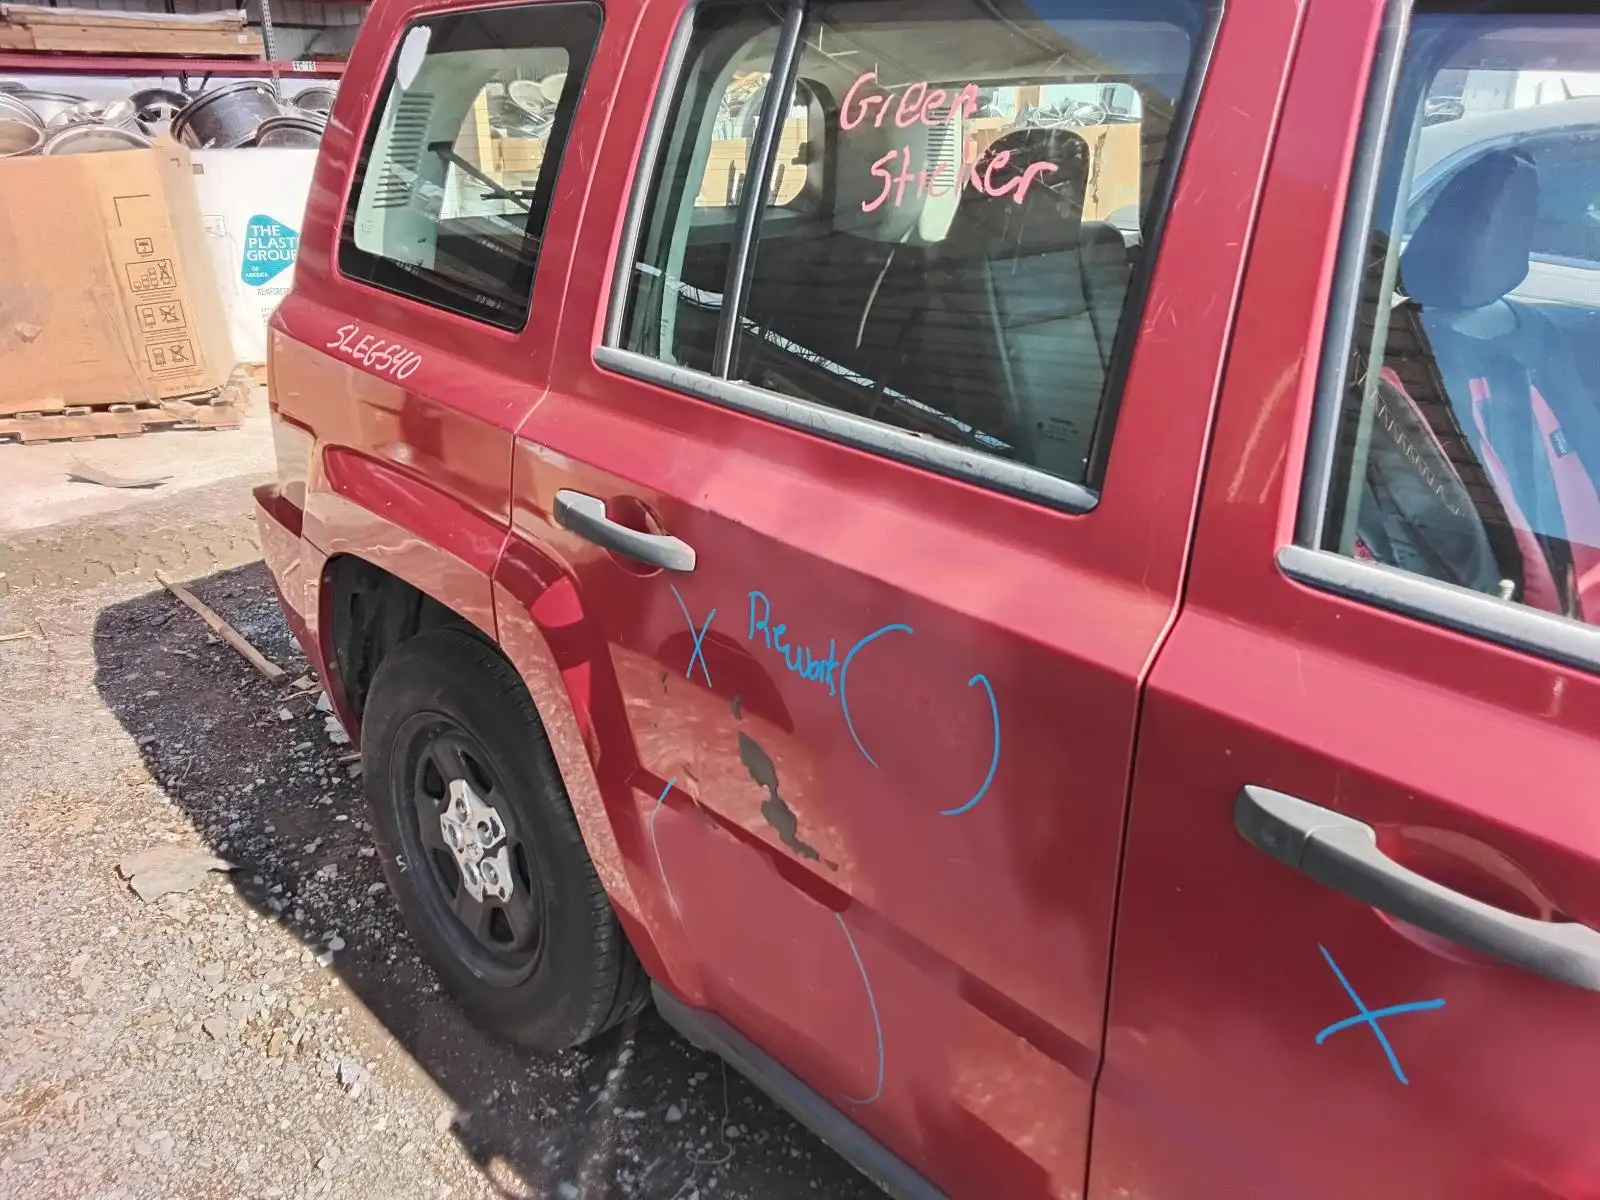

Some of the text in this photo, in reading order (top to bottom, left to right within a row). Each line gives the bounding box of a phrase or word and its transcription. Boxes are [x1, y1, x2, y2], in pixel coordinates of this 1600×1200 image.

[839, 72, 978, 130] Green
[861, 145, 1058, 212] Sticker
[250, 225, 281, 236] THE
